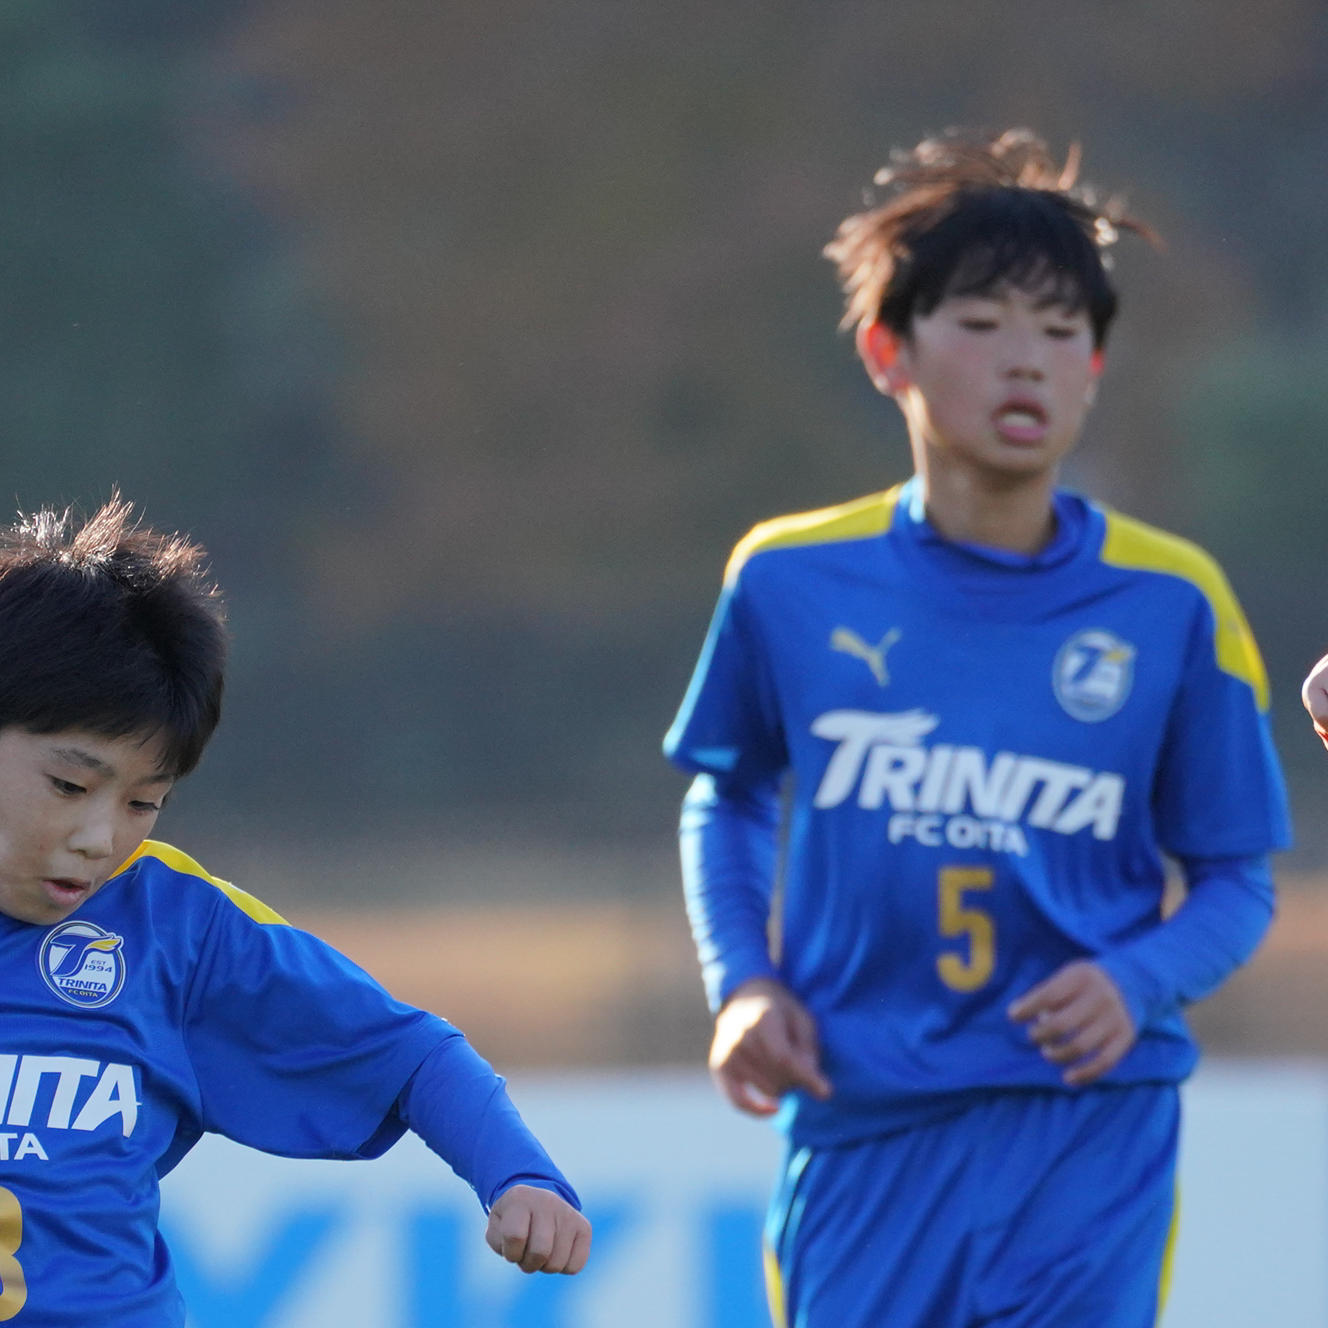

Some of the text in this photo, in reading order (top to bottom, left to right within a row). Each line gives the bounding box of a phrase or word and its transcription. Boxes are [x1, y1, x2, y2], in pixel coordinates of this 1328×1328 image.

[810, 708, 1126, 841] TRINITA
[888, 814, 1030, 858] FC OITA
[936, 865, 995, 993] 5
[58, 978, 108, 991] TRINITA
[84, 964, 113, 973] 1994
